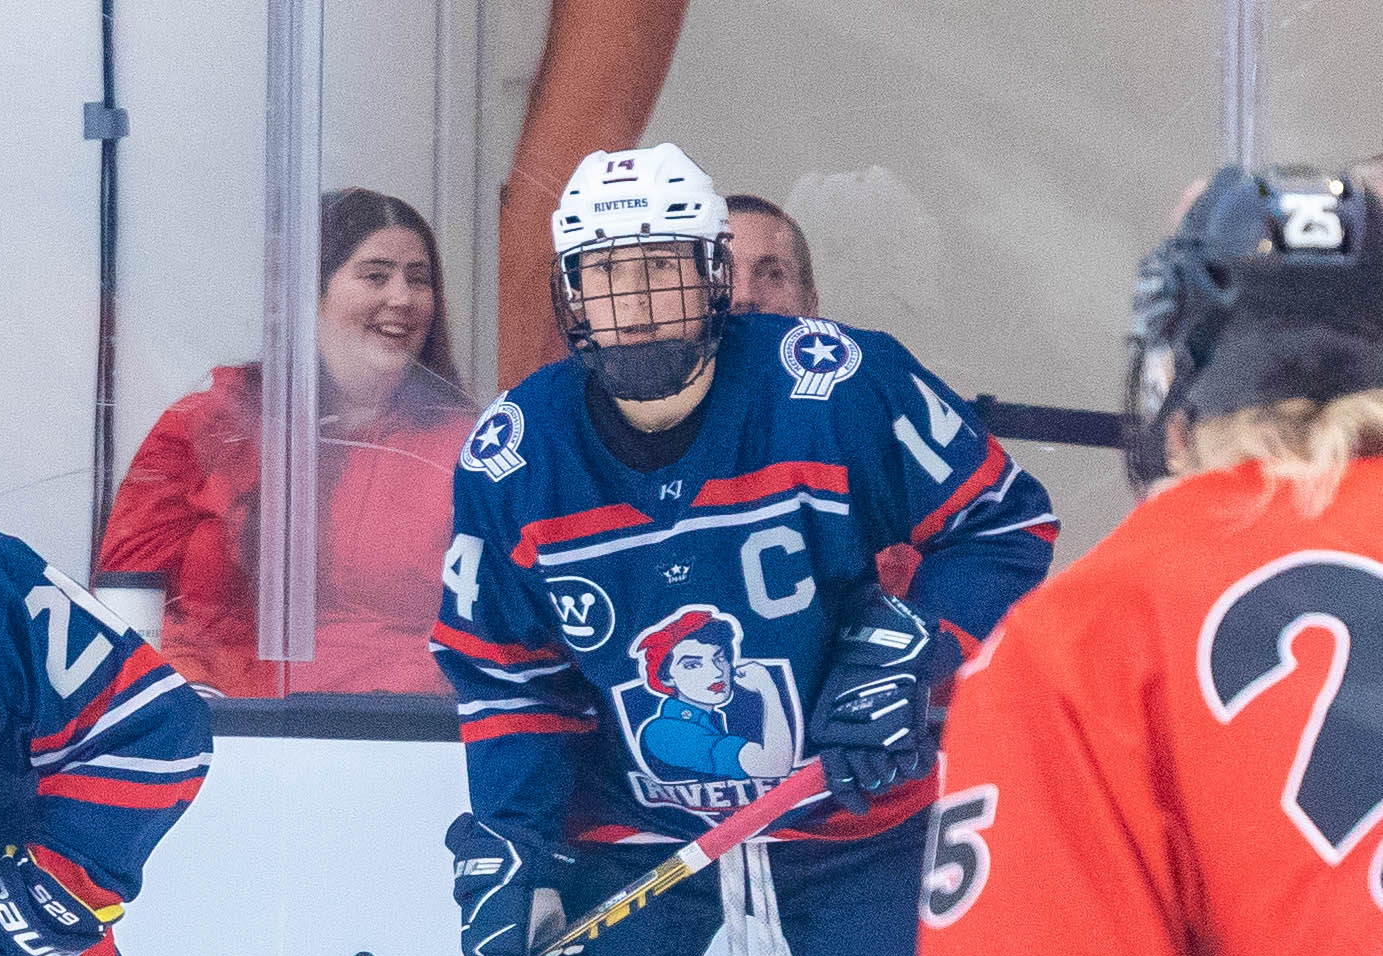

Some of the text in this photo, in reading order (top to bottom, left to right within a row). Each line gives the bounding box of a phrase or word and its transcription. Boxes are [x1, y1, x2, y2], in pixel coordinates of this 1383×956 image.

[594, 198, 648, 213] RIVETERS
[606, 159, 635, 173] 14
[892, 373, 978, 485] 14
[442, 533, 485, 621] 4
[740, 525, 816, 620] C
[1195, 549, 1383, 866] 2
[645, 777, 788, 808] RIVETE
[919, 752, 1000, 930] 5
